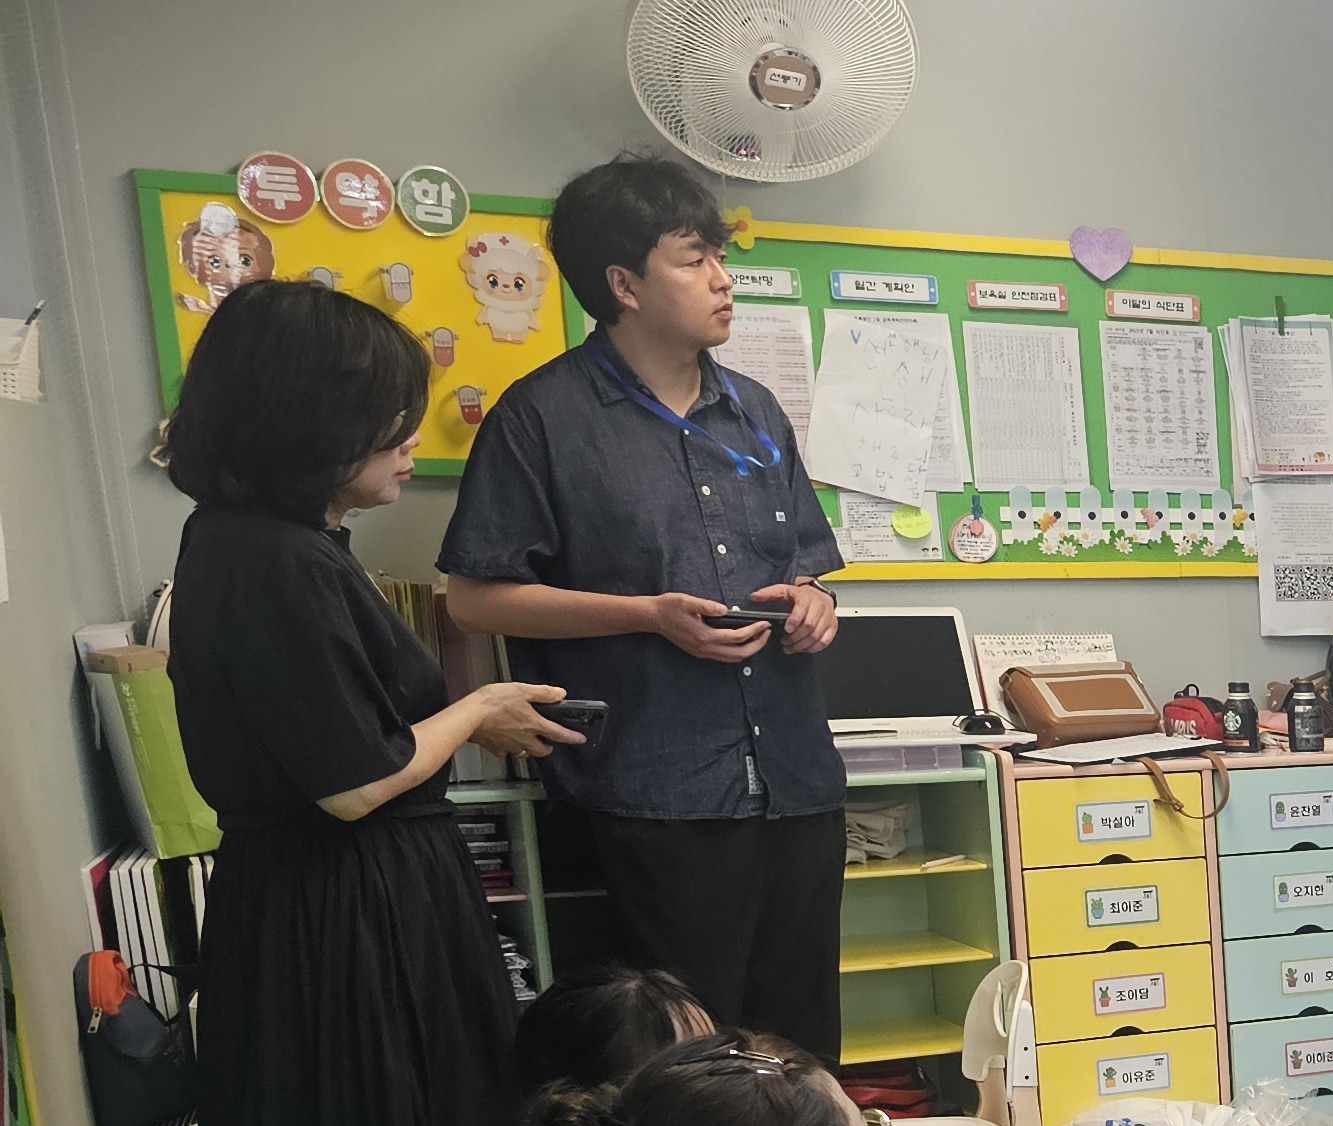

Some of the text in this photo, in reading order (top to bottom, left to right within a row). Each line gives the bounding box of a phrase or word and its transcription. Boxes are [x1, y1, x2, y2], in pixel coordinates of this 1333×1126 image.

[769, 72, 802, 87] 선풍기
[255, 165, 456, 225] 투약함
[978, 289, 1058, 302] 보육실 안전점검표
[1121, 298, 1185, 313] 이달의 식단표
[1289, 803, 1322, 819] 윤찬열
[1108, 899, 1144, 915] 최이준
[1303, 971, 1315, 984] 이
[1115, 987, 1150, 1003] 조이담
[1121, 1068, 1156, 1085] 이유준
